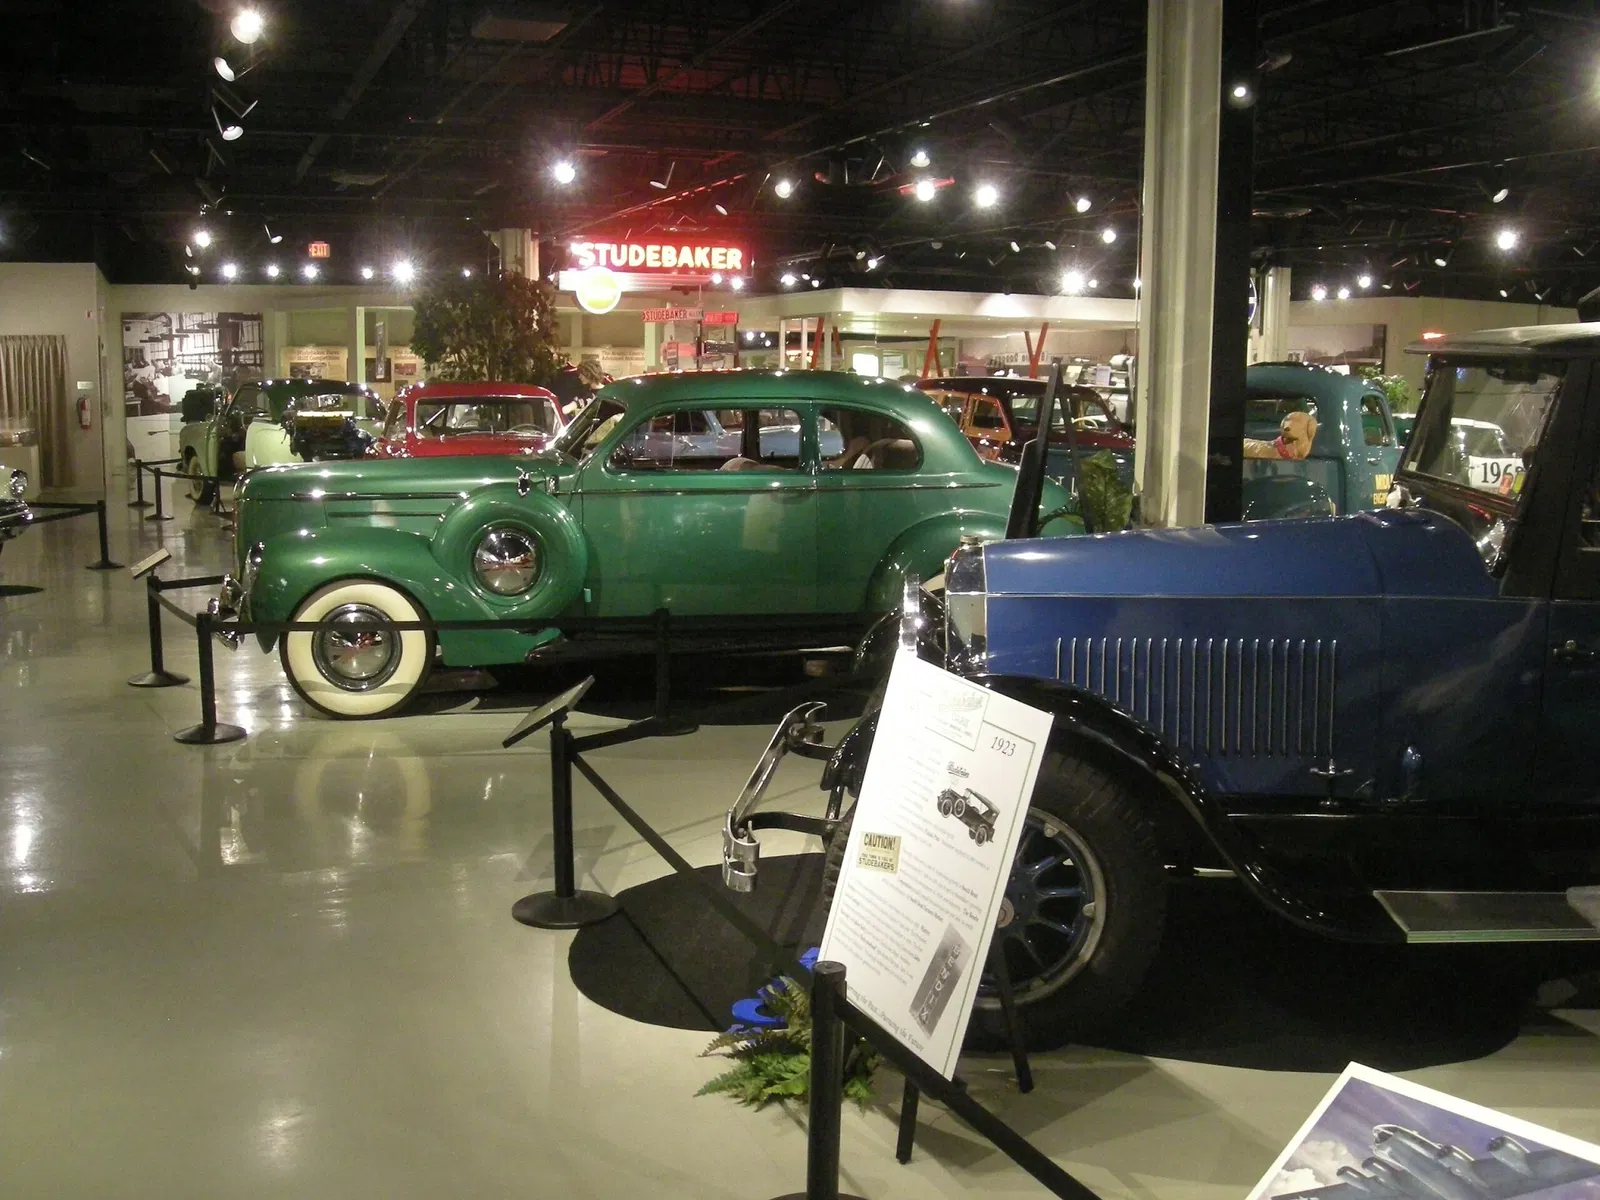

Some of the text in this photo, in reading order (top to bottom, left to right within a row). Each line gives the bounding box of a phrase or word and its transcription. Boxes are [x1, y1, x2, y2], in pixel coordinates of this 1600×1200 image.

[312, 245, 327, 257] EXIT
[577, 242, 743, 270] STUDEBAKER
[646, 309, 688, 321] STUDEBAKER
[991, 736, 1017, 757] 1923
[863, 833, 896, 851] CAUTION!
[858, 857, 895, 871] STUDEBAKERS
